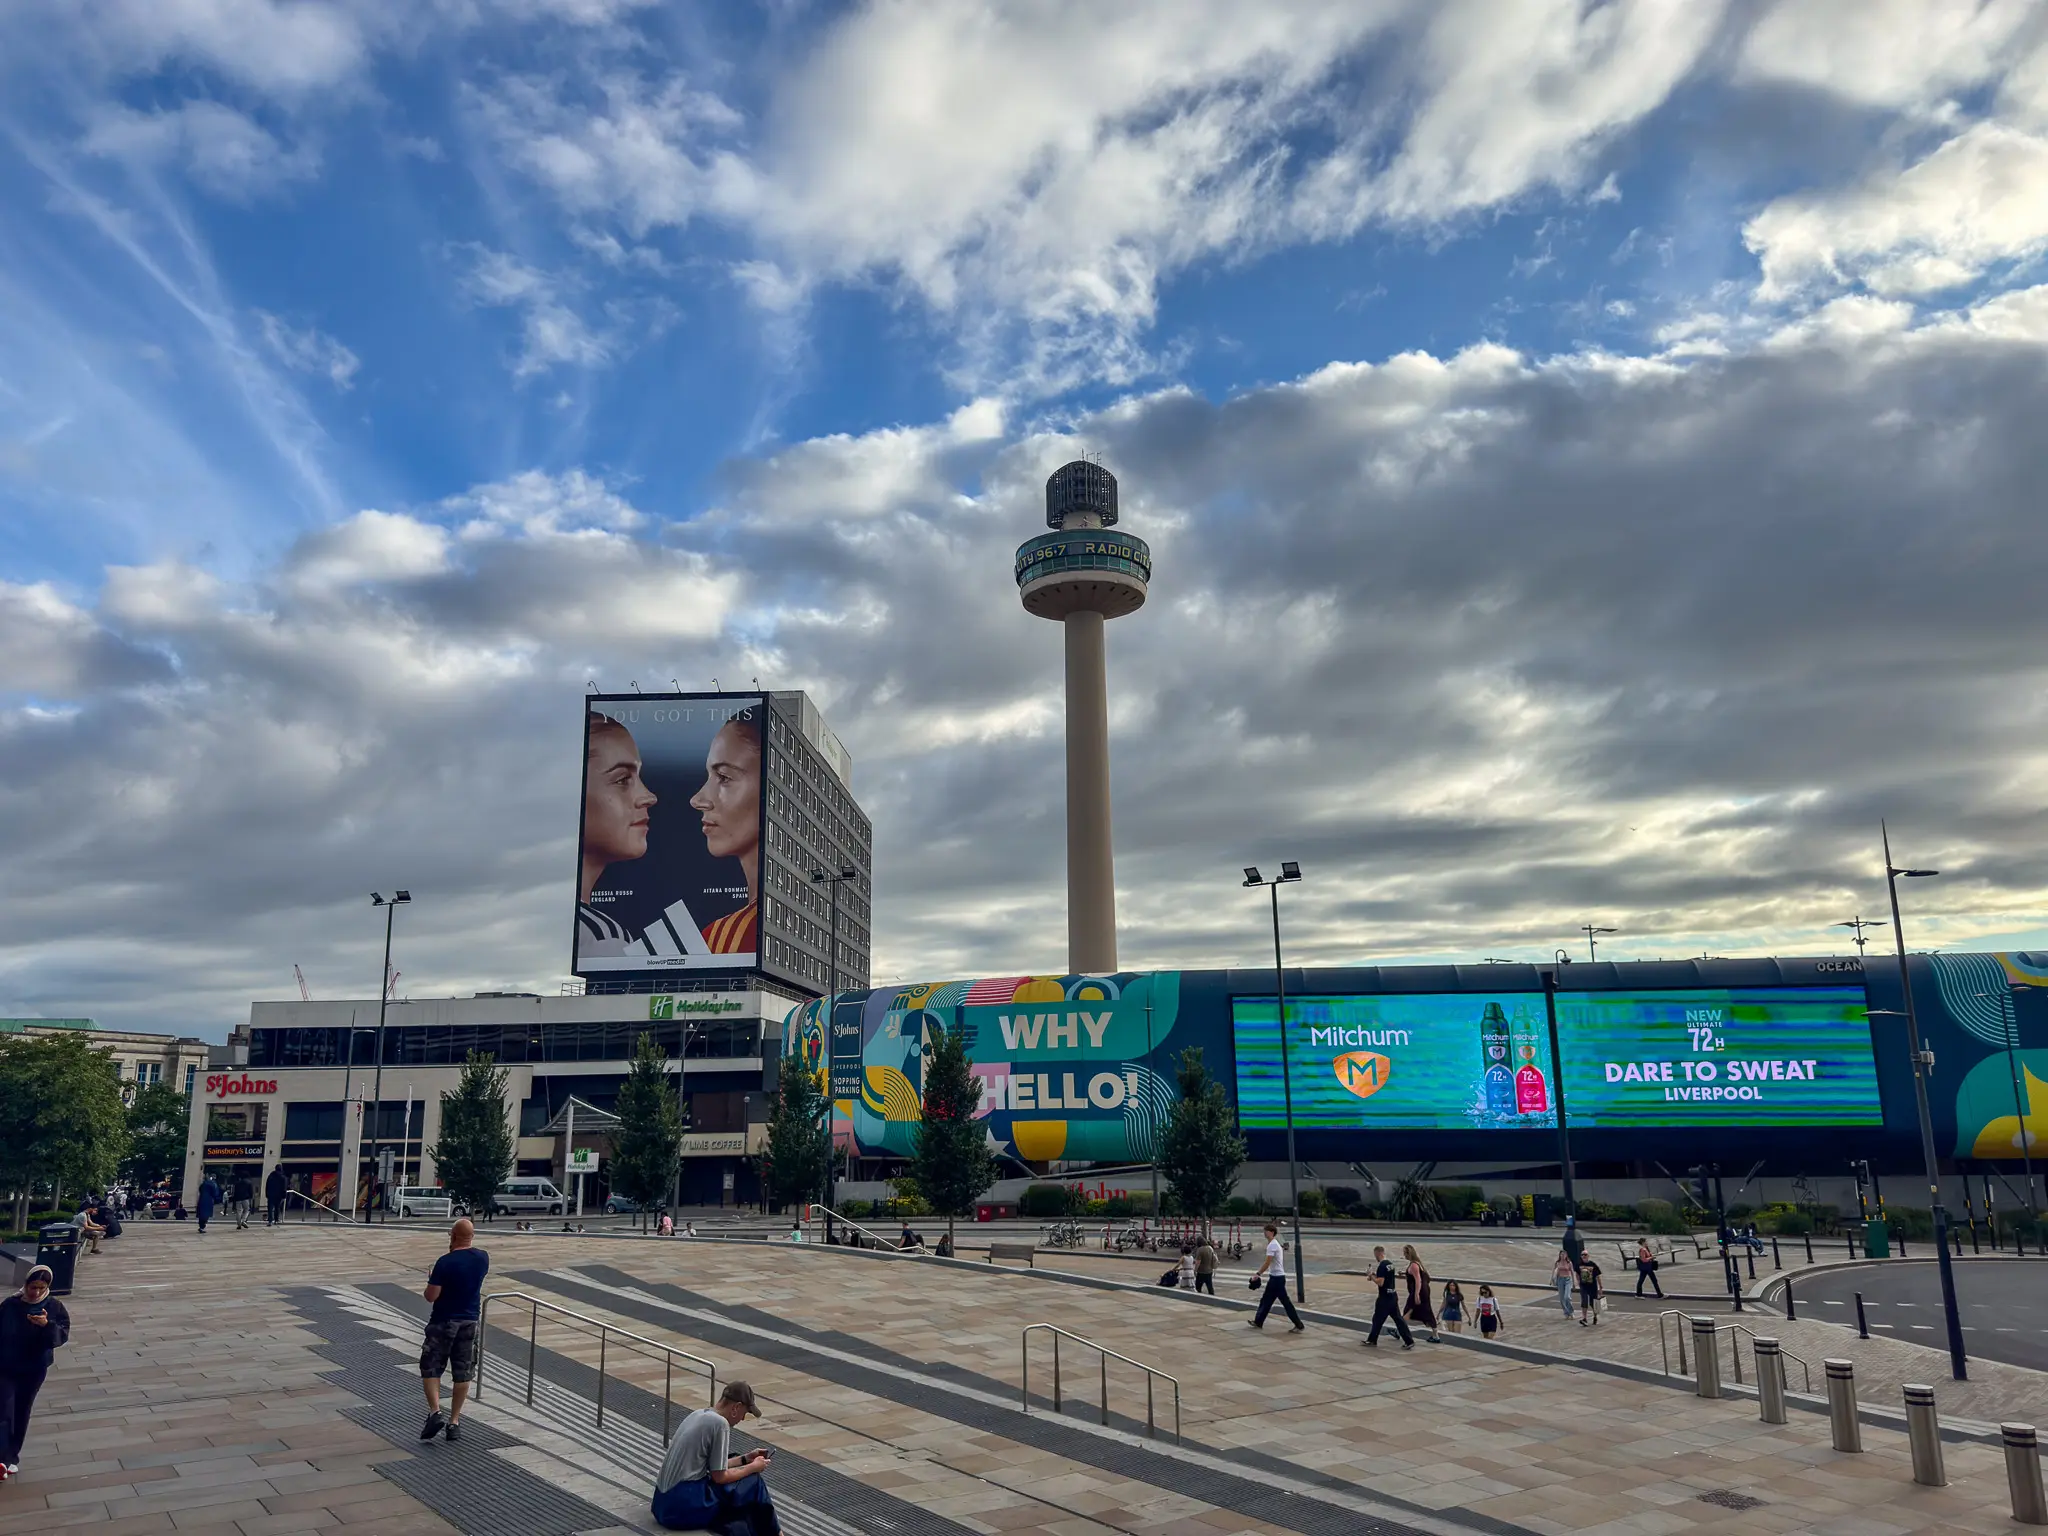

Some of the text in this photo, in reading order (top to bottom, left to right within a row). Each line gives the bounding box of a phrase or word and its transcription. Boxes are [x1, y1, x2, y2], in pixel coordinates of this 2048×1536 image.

[1085, 543, 1151, 570] RADIO CITY
[602, 707, 753, 724] YOU GOT THIS
[1816, 961, 1863, 972] OCEAN
[1686, 1009, 1723, 1022] NEW
[998, 1012, 1113, 1050] WHY
[1605, 1060, 1817, 1083] DARE TO SWEAT
[833, 1077, 860, 1085] HOPPING
[834, 1086, 860, 1094] PARKING
[978, 1072, 1139, 1110] HELLO!
[1664, 1086, 1763, 1101] LIVERPOOL
[207, 1146, 262, 1156] Sainsbury's Local
[689, 1141, 708, 1150] LIME
[710, 1140, 742, 1150] COFFEE
